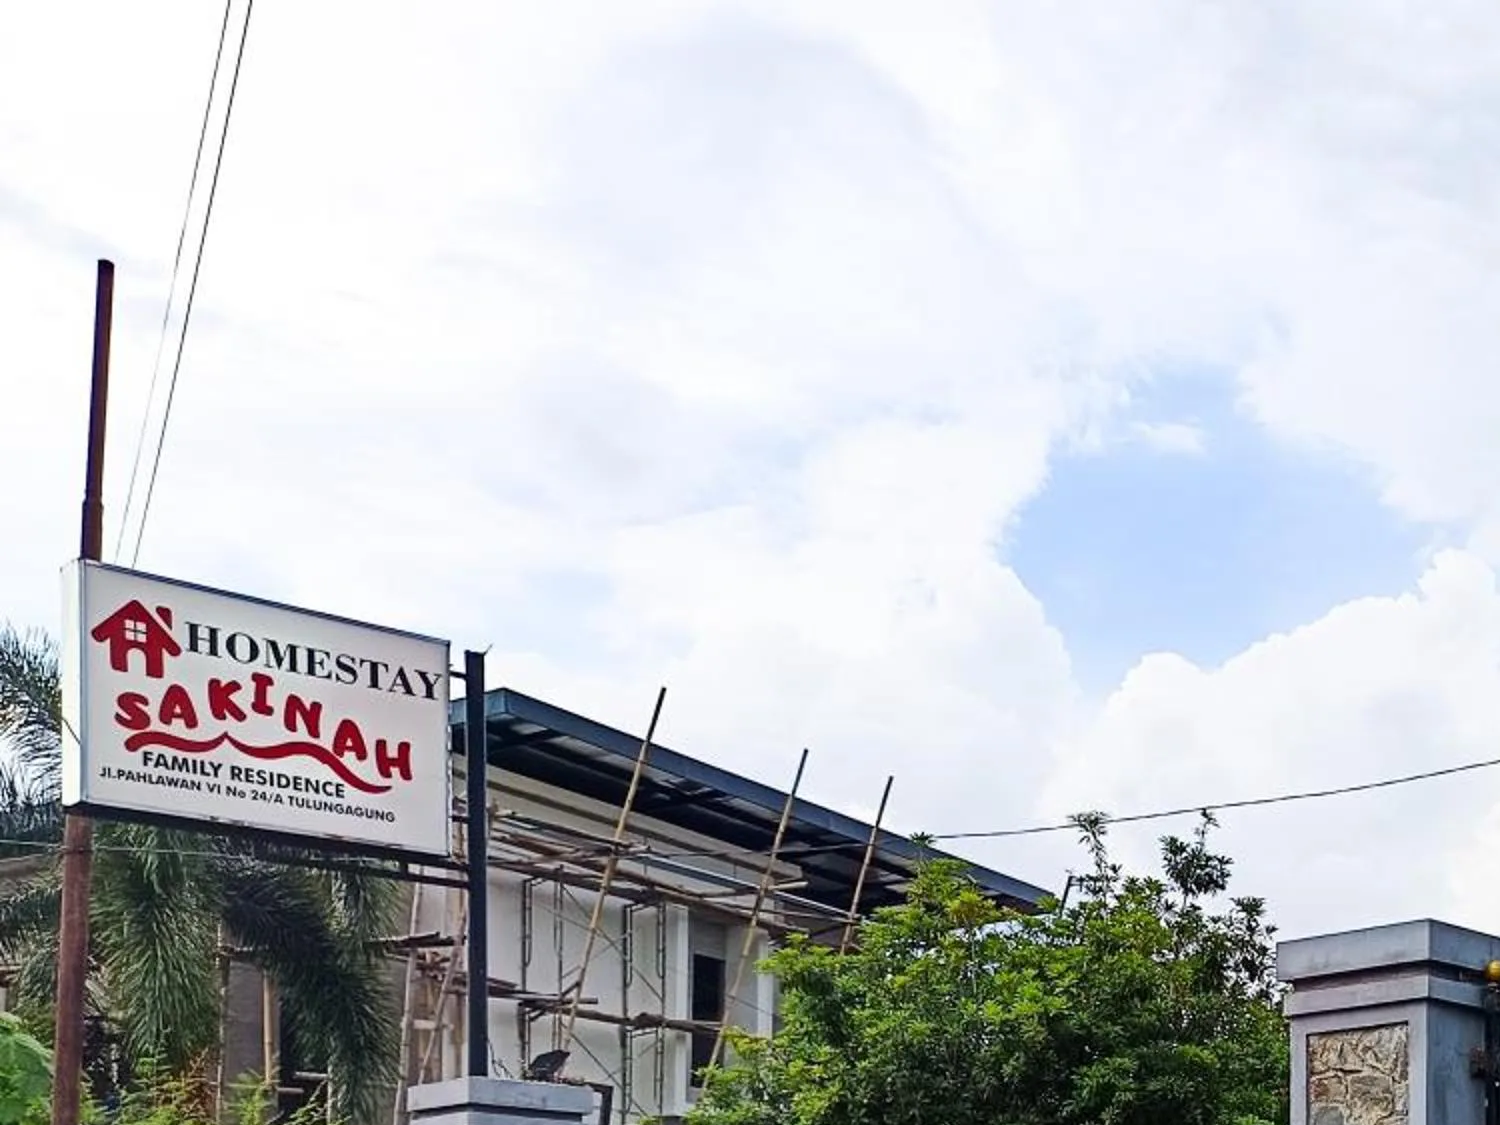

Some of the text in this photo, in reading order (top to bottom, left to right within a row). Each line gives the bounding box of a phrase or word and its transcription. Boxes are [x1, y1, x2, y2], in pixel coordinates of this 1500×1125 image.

[184, 621, 443, 700] HOMESTAY
[114, 672, 413, 782] SAKINAH
[143, 751, 346, 799] FAMILY RESIDENCE
[206, 781, 221, 795] VI
[251, 789, 284, 805] 24/A
[288, 796, 396, 823] TULUNGAGUNG
